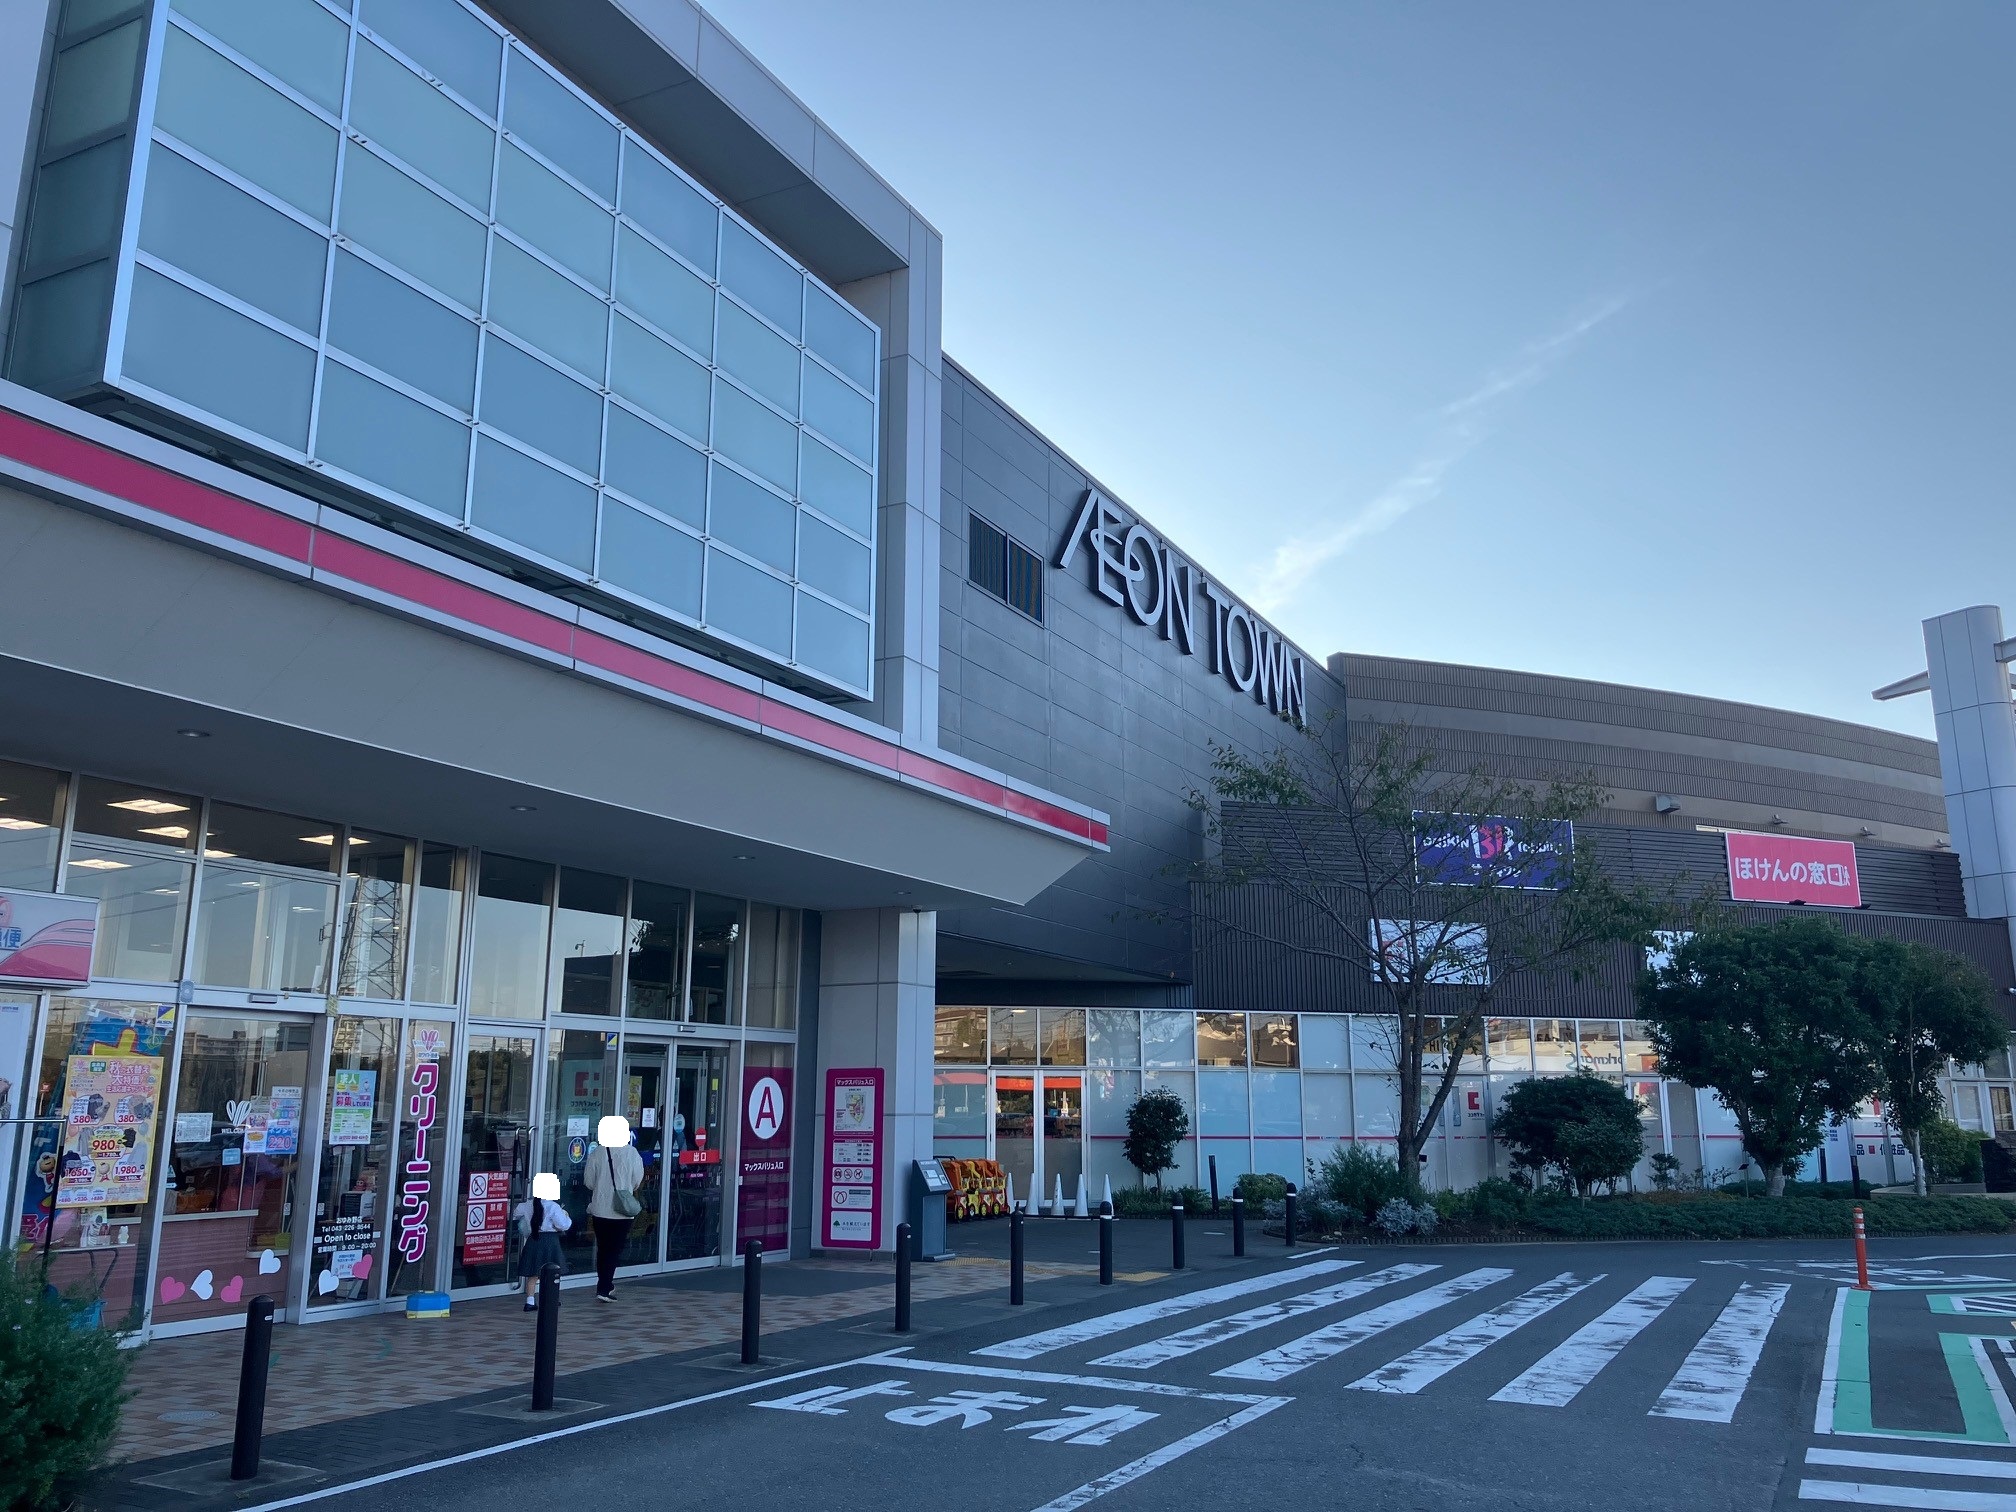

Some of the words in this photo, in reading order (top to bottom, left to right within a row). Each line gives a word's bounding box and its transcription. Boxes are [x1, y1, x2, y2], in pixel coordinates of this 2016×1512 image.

[1201, 577, 1307, 727] TOWN
[755, 1086, 776, 1129] A
[269, 1136, 292, 1150] 220
[693, 1152, 707, 1161] 出口
[399, 1063, 439, 1263] クリーニング
[744, 1161, 784, 1172] マックスバリュ入口
[324, 1234, 344, 1243] Open
[345, 1233, 352, 1241] to
[353, 1232, 371, 1240] close
[748, 1380, 1161, 1446] 止まれ
